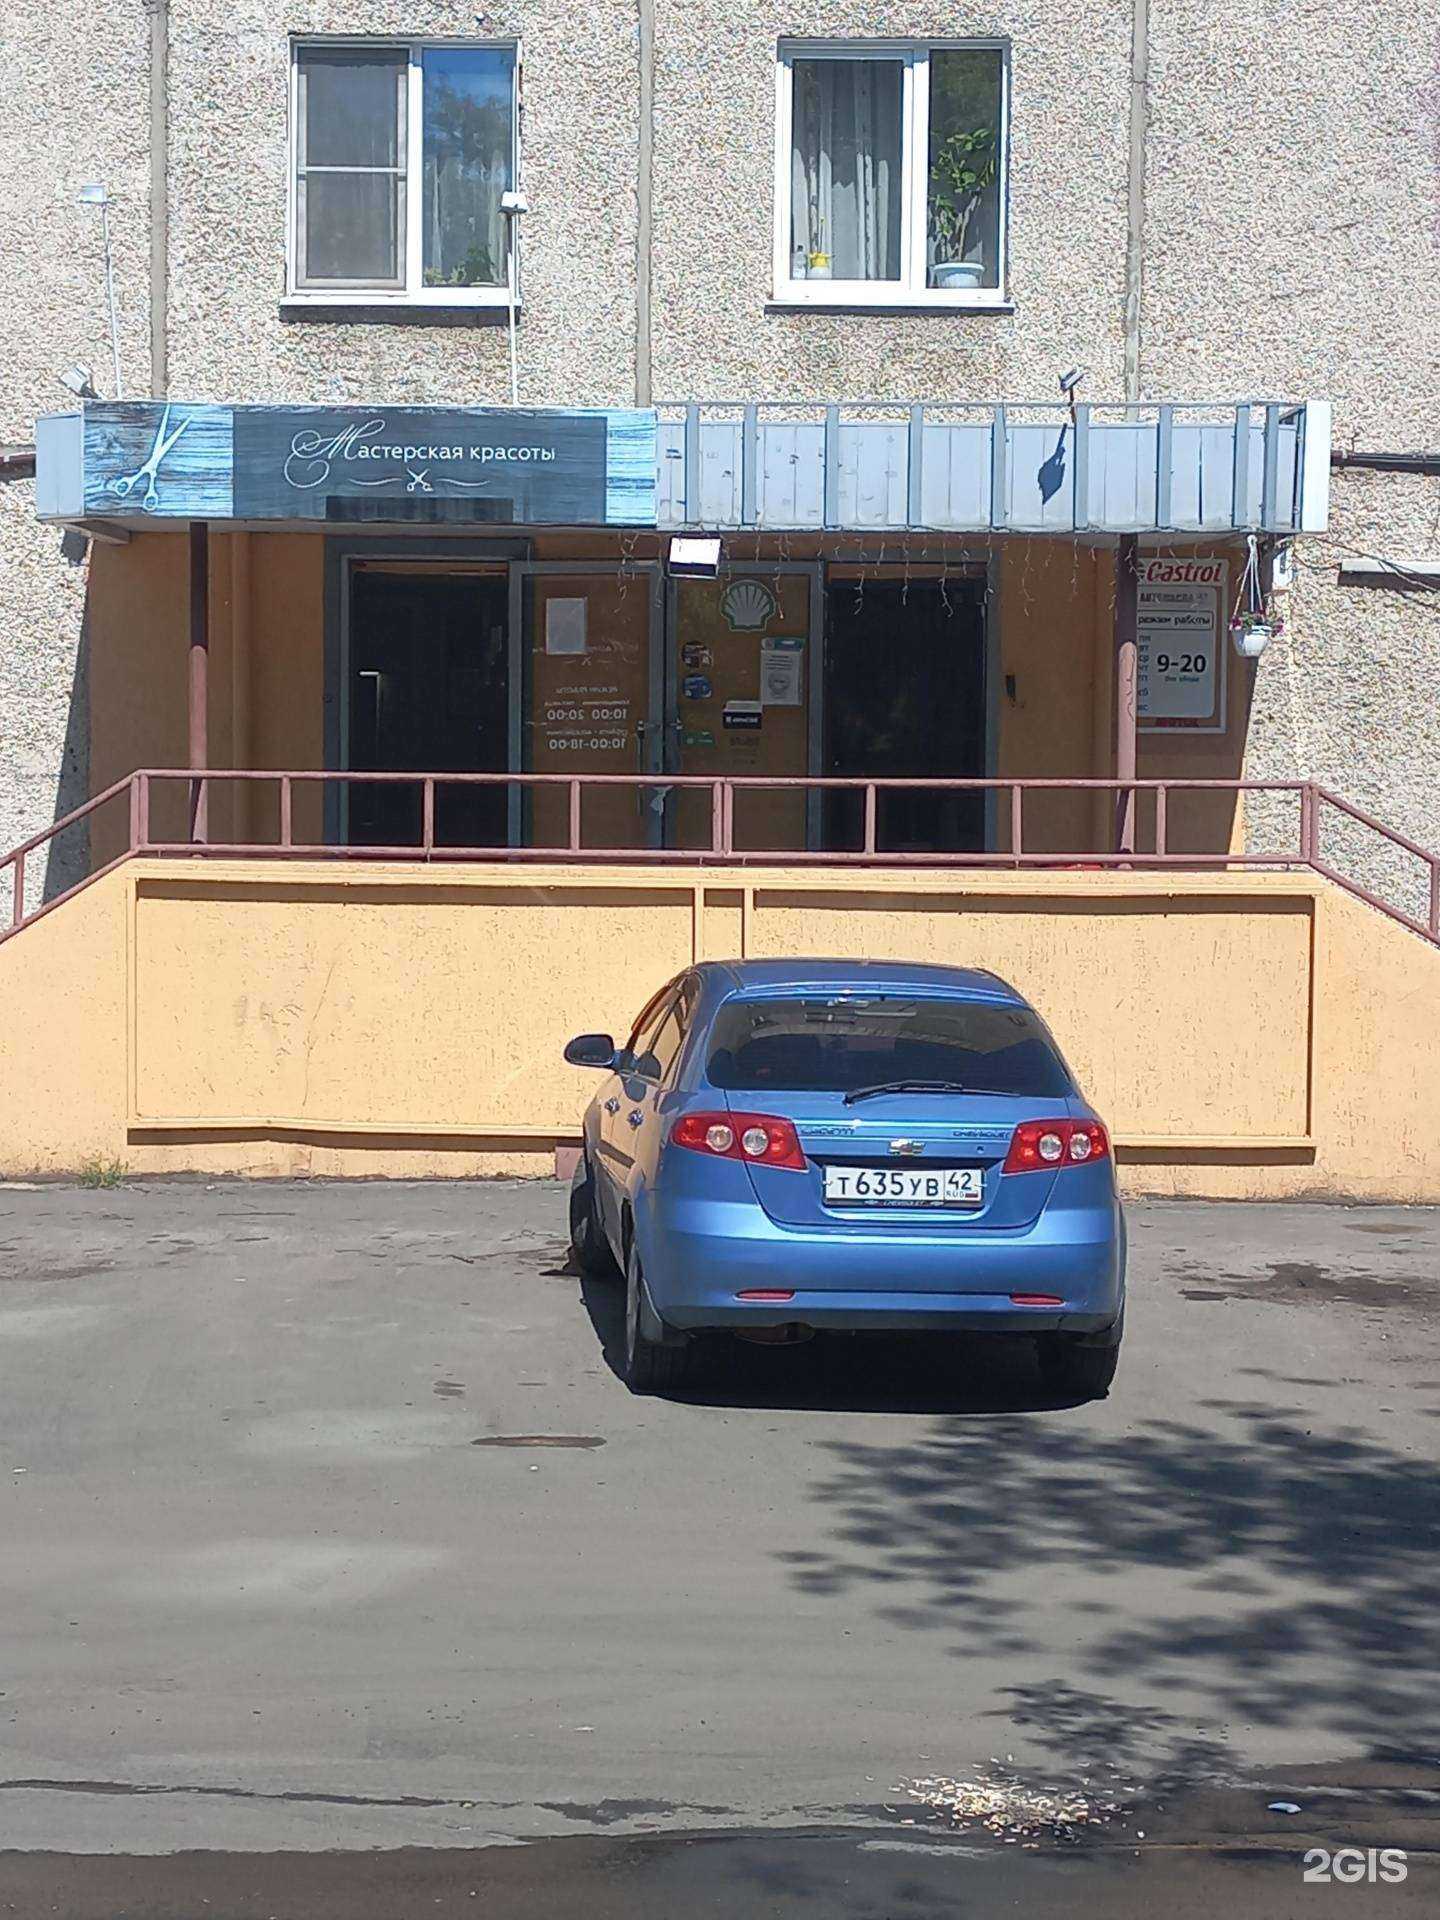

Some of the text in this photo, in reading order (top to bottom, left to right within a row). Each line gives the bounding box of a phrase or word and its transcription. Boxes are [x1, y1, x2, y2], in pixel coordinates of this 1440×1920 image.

[284, 419, 556, 488] Мастерская красоты
[1147, 561, 1222, 583] Castrol
[1157, 654, 1206, 673] 9-20
